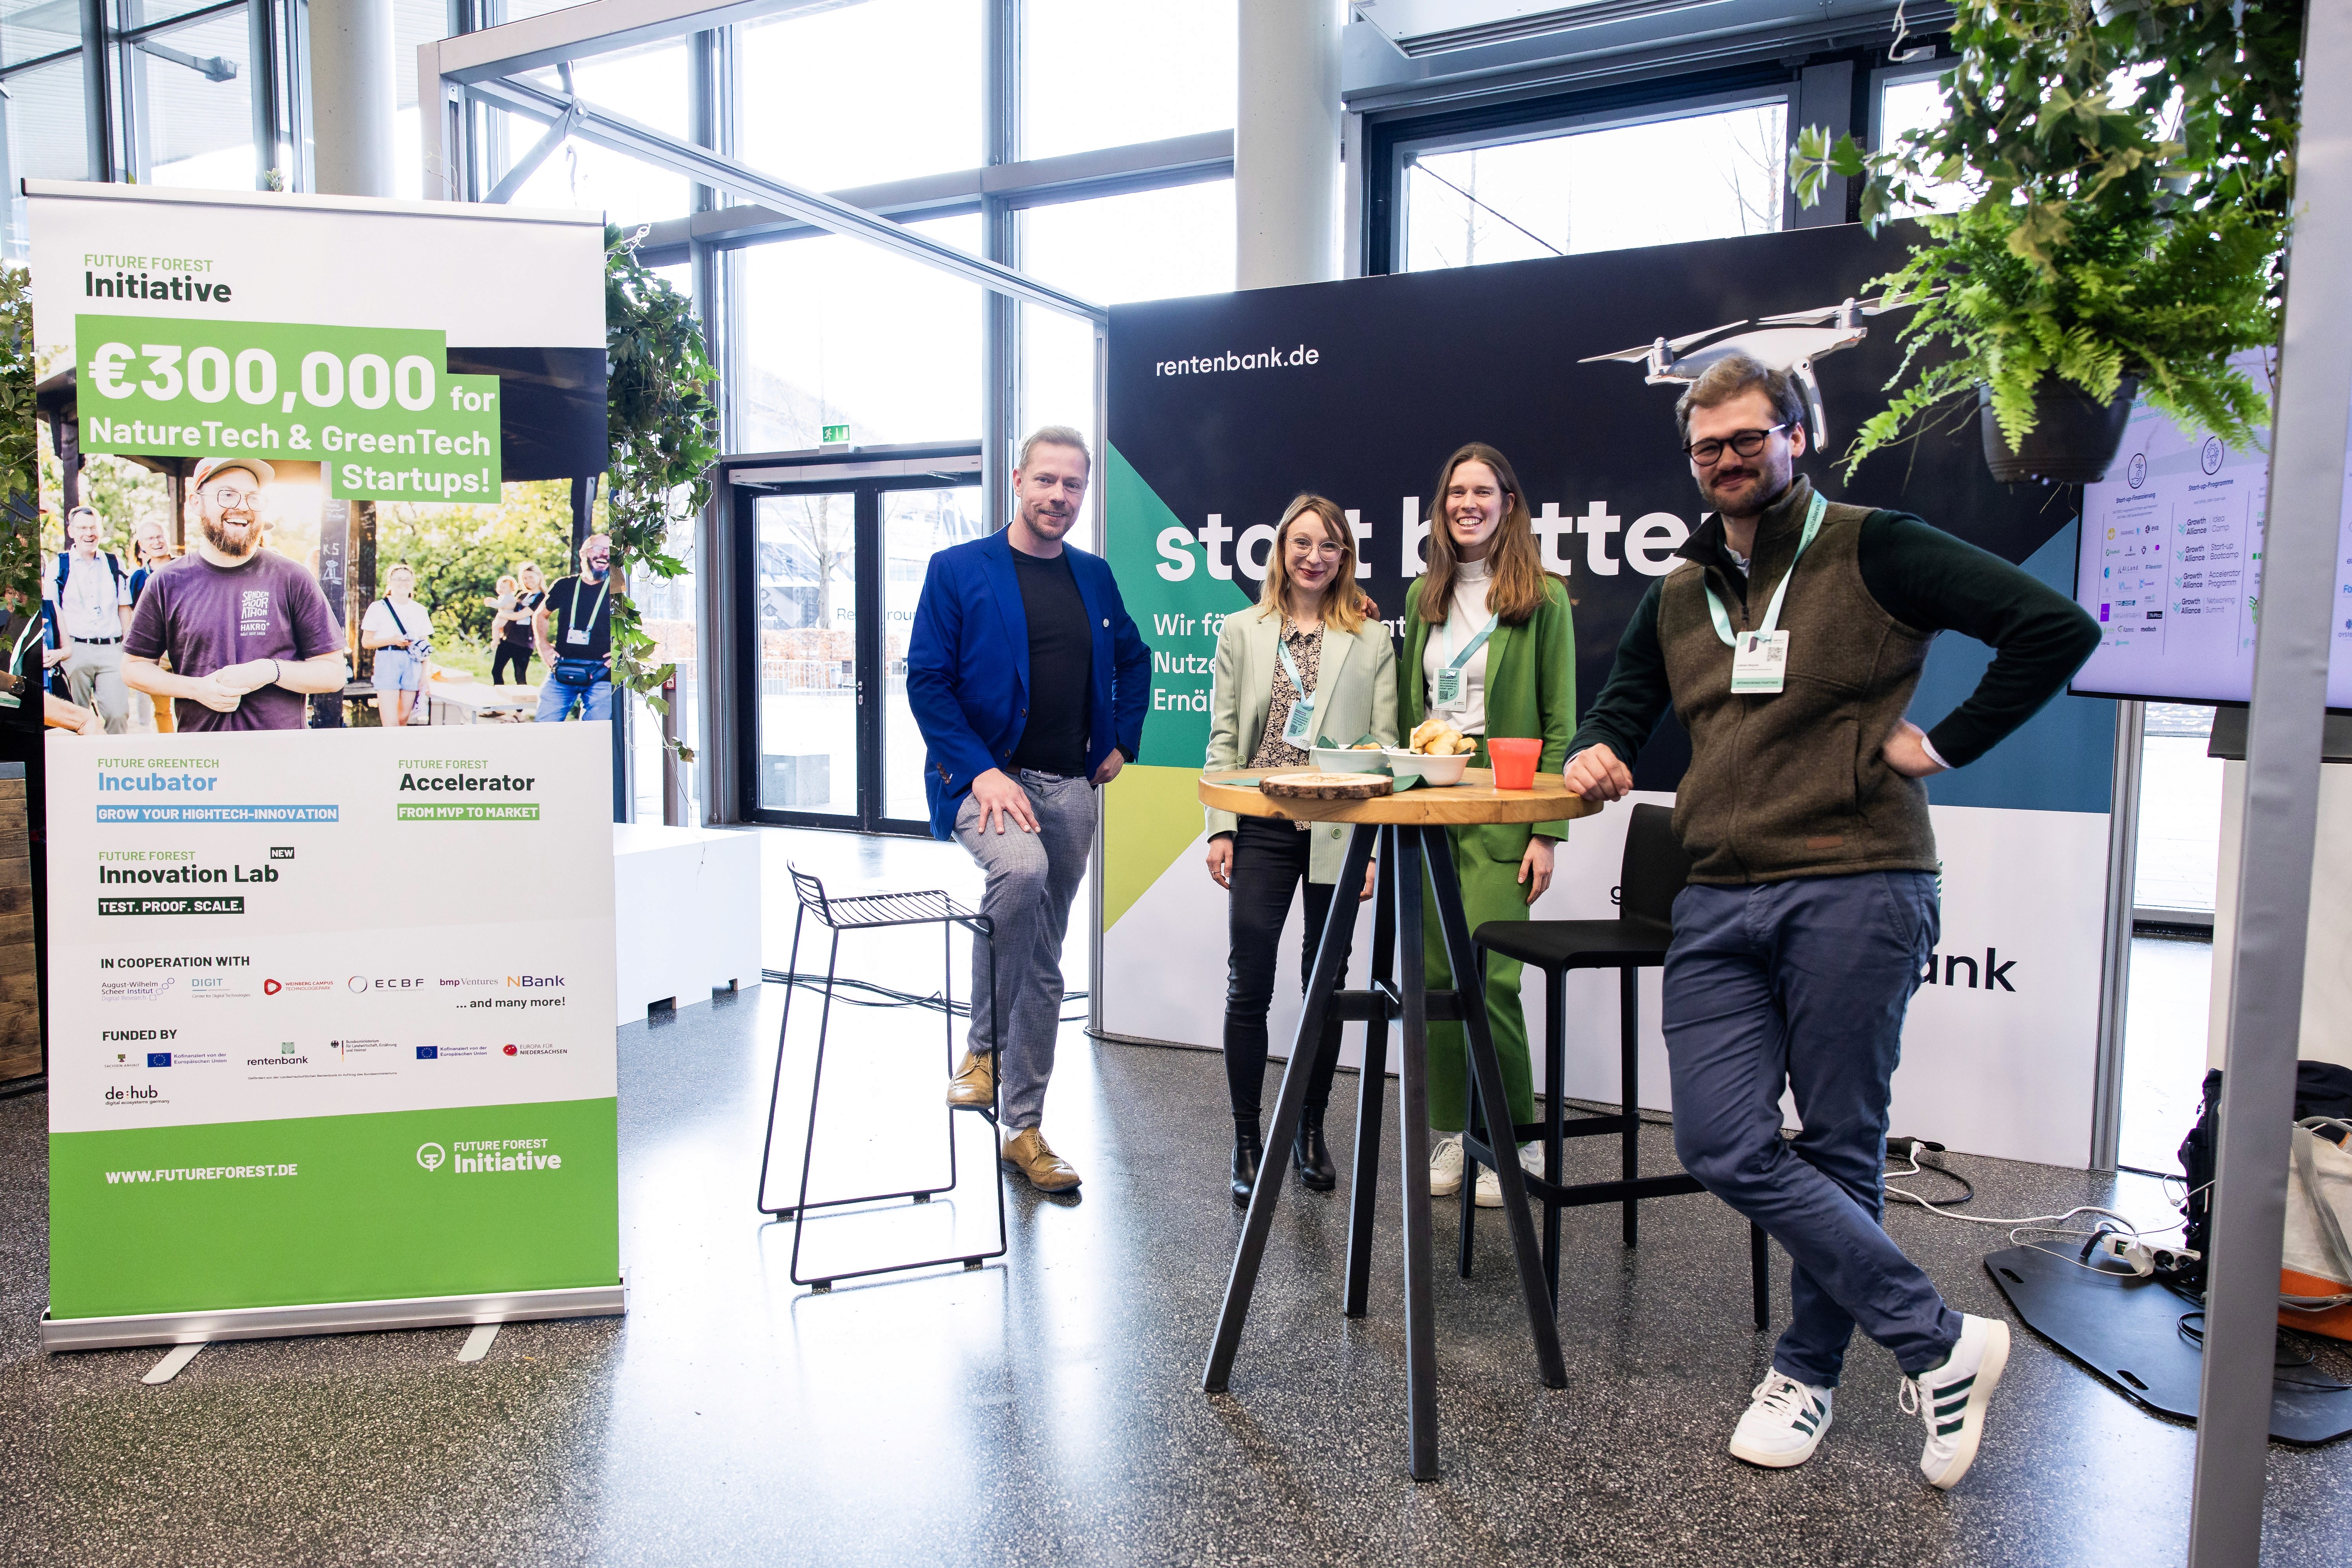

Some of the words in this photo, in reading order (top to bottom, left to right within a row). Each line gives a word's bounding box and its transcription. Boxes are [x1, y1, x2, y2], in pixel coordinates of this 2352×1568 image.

[85, 254, 147, 269] FUTURE
[151, 257, 213, 272] FOREST
[86, 271, 232, 303] Initiative
[1156, 344, 1319, 376] rentenbank.de
[89, 342, 436, 414] €300,000
[450, 386, 495, 412] for
[89, 417, 280, 449] NatureTech
[288, 424, 312, 450] &
[322, 425, 491, 456] GreenTech
[342, 464, 490, 499] Startups!
[2188, 479, 2234, 491] Start-up-Programme
[2186, 517, 2206, 526] Growth
[2186, 527, 2207, 535] Alliance
[2185, 544, 2205, 554] Growth
[2210, 552, 2239, 560] Bootcamp
[2183, 572, 2203, 580] Growth
[2208, 570, 2241, 578] Accelerator
[2208, 580, 2237, 588] Programm
[240, 623, 267, 632] HAKRO
[1153, 613, 1196, 636] Wir
[98, 759, 145, 768] FUTURE
[148, 759, 220, 768] GREENTECH
[398, 760, 443, 769] FUTURE
[445, 760, 488, 769] FOREST
[99, 773, 217, 791] Incubator
[399, 773, 535, 791] Accelerator
[98, 809, 138, 820] GROW
[143, 809, 179, 820] YOUR
[182, 808, 337, 820] HIGHTECH-INNOVATION
[399, 807, 434, 817] FROM
[437, 807, 464, 817] MVP
[466, 807, 483, 817] TO
[486, 807, 538, 817] MARKET
[99, 851, 146, 861] FUTURE
[149, 851, 196, 860] FOREST
[271, 849, 293, 858] NEW
[99, 864, 227, 884] Innovation
[235, 864, 279, 882] Lab
[100, 902, 139, 913] TEST.
[142, 901, 191, 912] PROOF.
[194, 900, 242, 911] SCALE.
[101, 959, 115, 969] IN
[118, 957, 212, 968] COOPERATION
[216, 956, 250, 966] WITH
[192, 978, 223, 987] DIGIT
[507, 975, 565, 987] NBank
[470, 999, 492, 1007] and
[495, 998, 526, 1009] many
[531, 997, 566, 1006] more!
[103, 1031, 156, 1041] FUNDED
[161, 1030, 177, 1040] BY
[247, 1056, 308, 1065] rentenbank
[454, 1141, 500, 1151] FUTURE
[503, 1139, 548, 1149] FOREST
[455, 1151, 561, 1173] Initiative
[106, 1164, 298, 1184] WWW.FUTUREFOREST.DE
